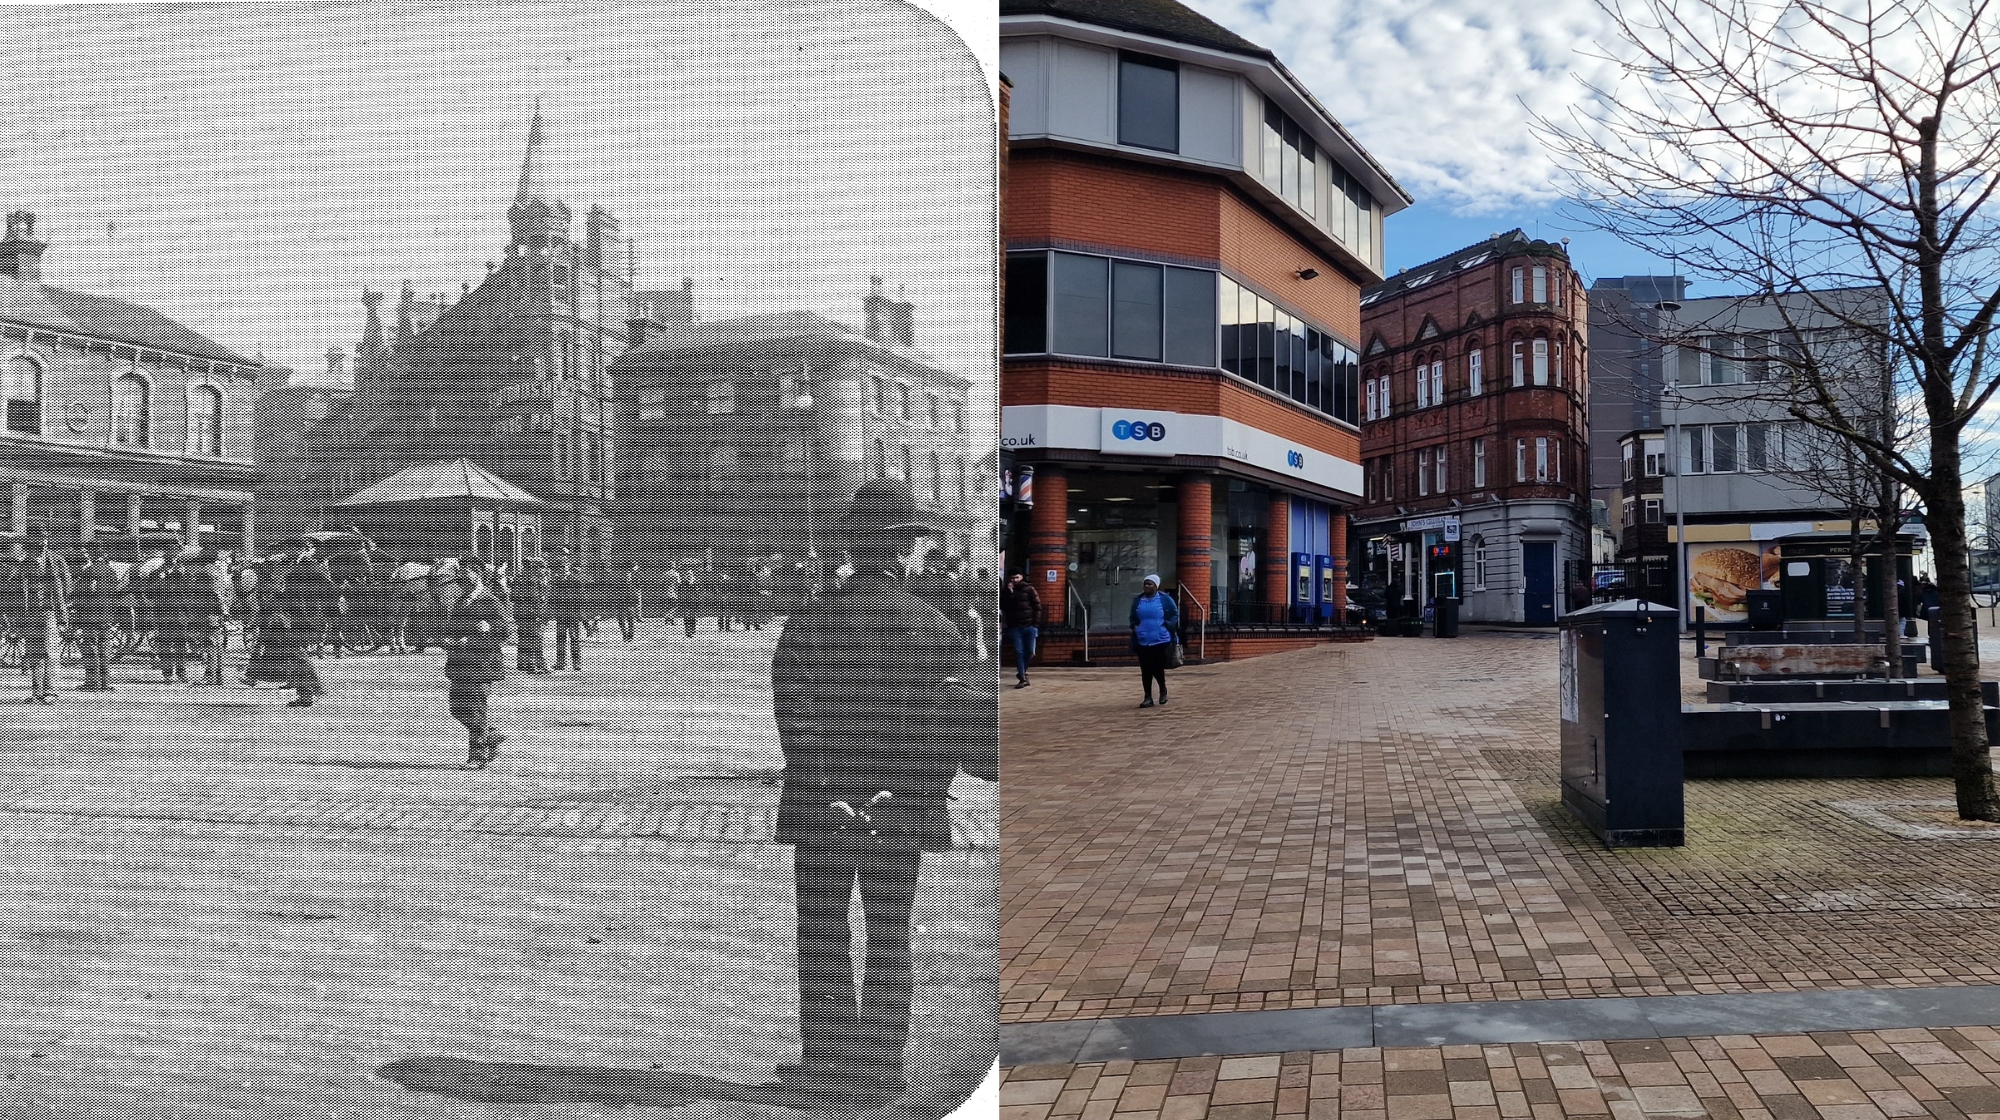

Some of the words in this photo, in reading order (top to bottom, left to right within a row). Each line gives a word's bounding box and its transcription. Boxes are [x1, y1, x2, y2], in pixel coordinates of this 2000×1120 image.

[1116, 422, 1163, 440] TSB
[1227, 446, 1249, 460] tsb.co.uk
[1289, 451, 1303, 468] TSB
